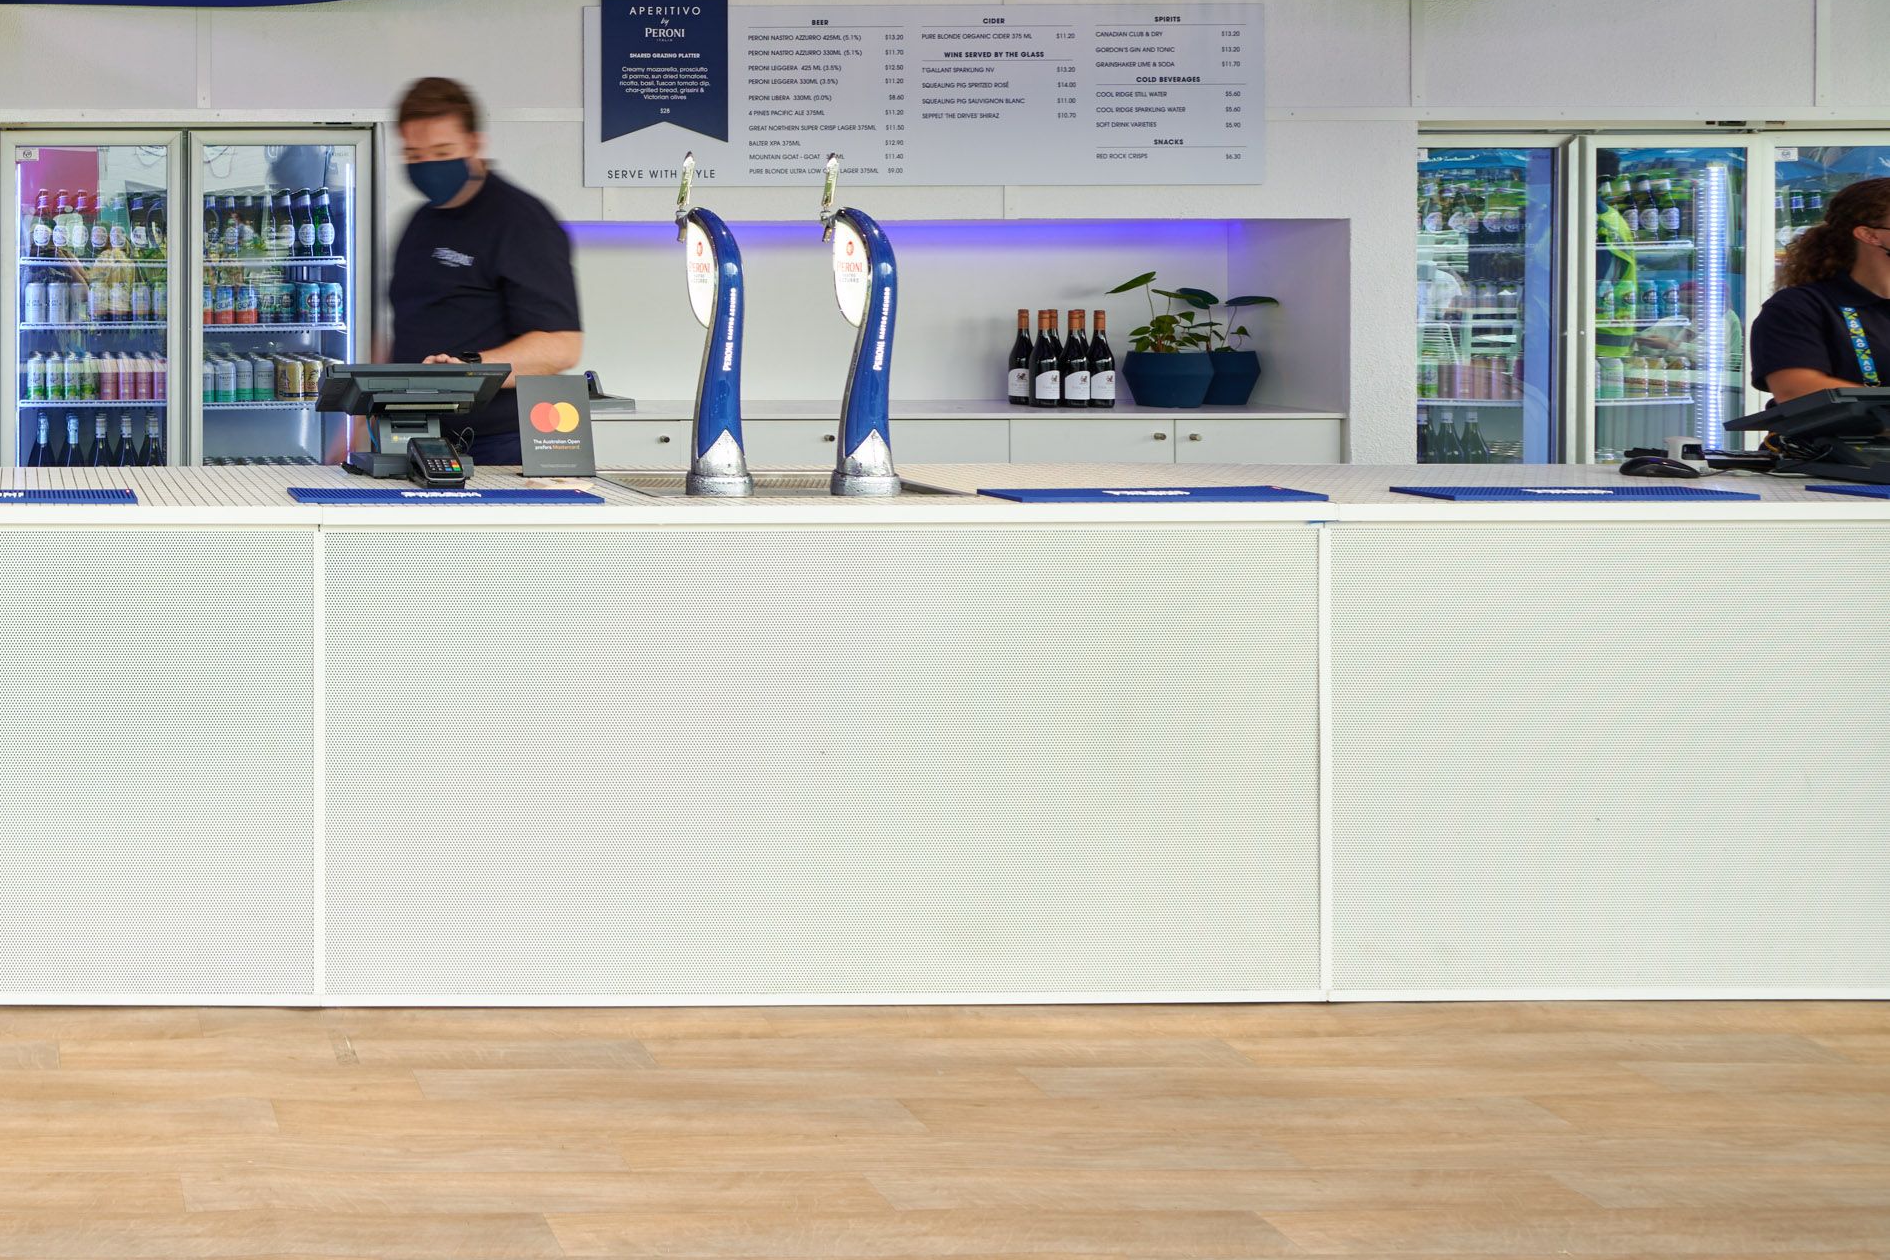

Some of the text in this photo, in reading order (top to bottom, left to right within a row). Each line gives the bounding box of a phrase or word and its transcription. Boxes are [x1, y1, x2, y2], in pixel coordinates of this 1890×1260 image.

[630, 7, 700, 15] APERITIVO
[661, 18, 669, 27] by
[645, 28, 684, 37] PERONI
[622, 72, 628, 80] di
[652, 72, 661, 80] sun
[656, 79, 676, 87] Tuscan
[677, 79, 698, 87] tomato
[626, 86, 658, 94] char-grilled
[680, 86, 698, 94] grissini
[608, 170, 643, 179] SERVE
[649, 170, 676, 178] WITH
[722, 341, 734, 371] PERONI
[873, 340, 886, 371] PERONI
